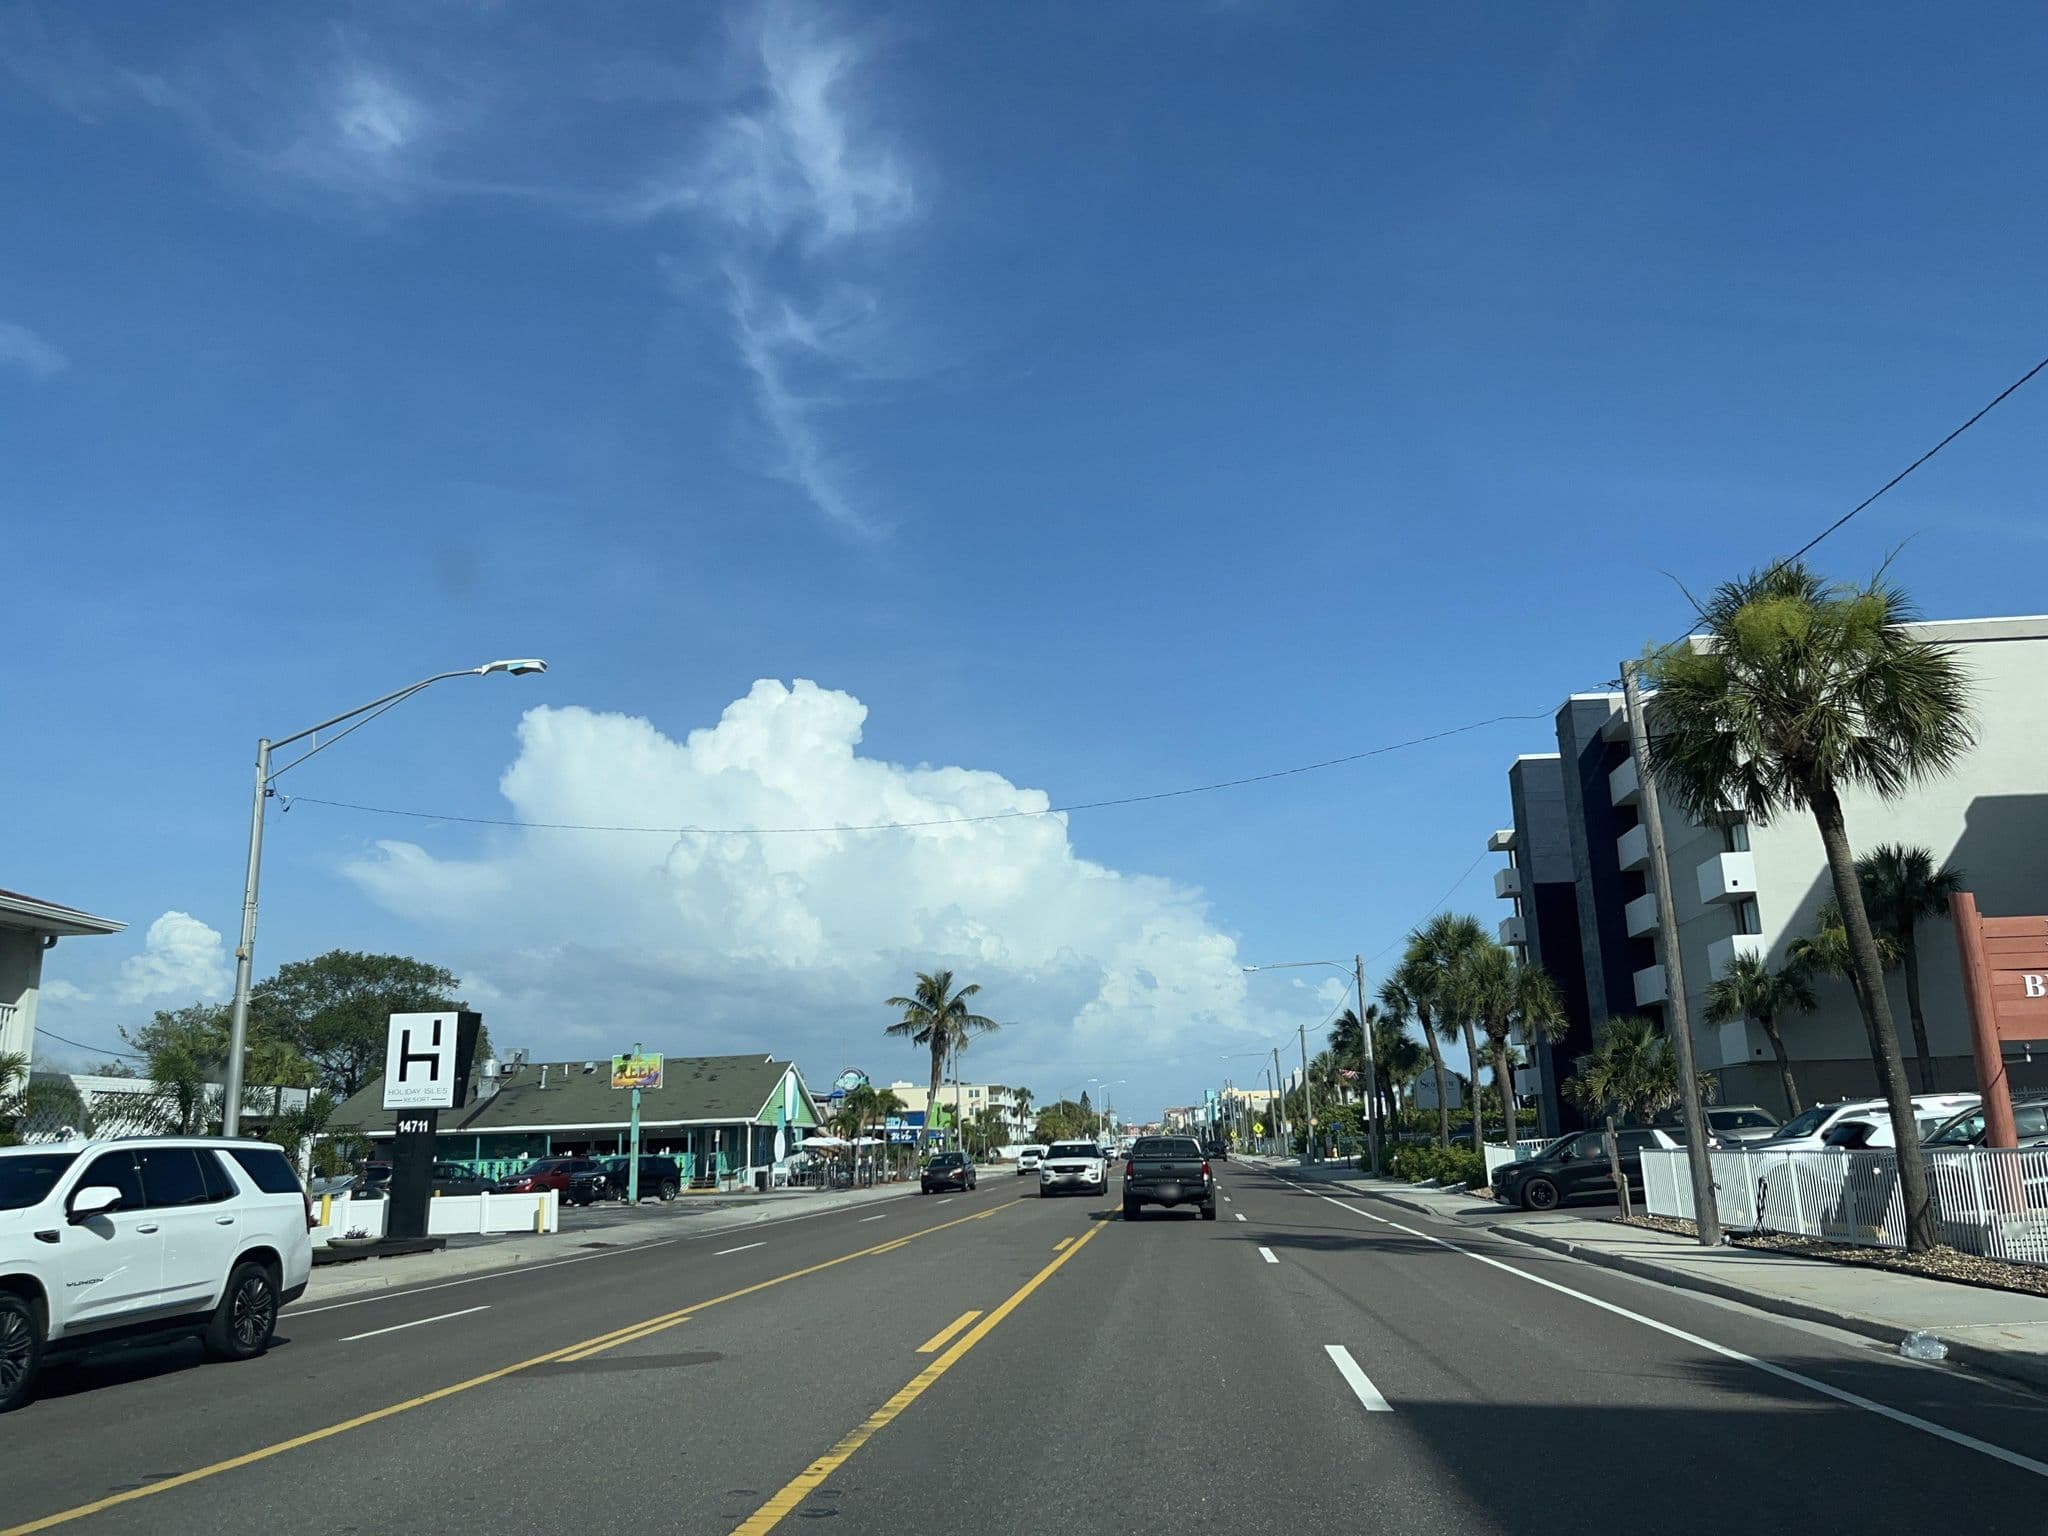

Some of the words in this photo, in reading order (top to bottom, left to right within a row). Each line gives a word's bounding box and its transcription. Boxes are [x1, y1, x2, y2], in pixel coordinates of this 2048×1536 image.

[2022, 974, 2048, 998] B
[399, 1019, 442, 1082] H
[388, 1088, 421, 1096] HOLIDAY
[424, 1087, 448, 1095] ISLES
[399, 1120, 428, 1133] 14711
[66, 1278, 104, 1287] YUKON
